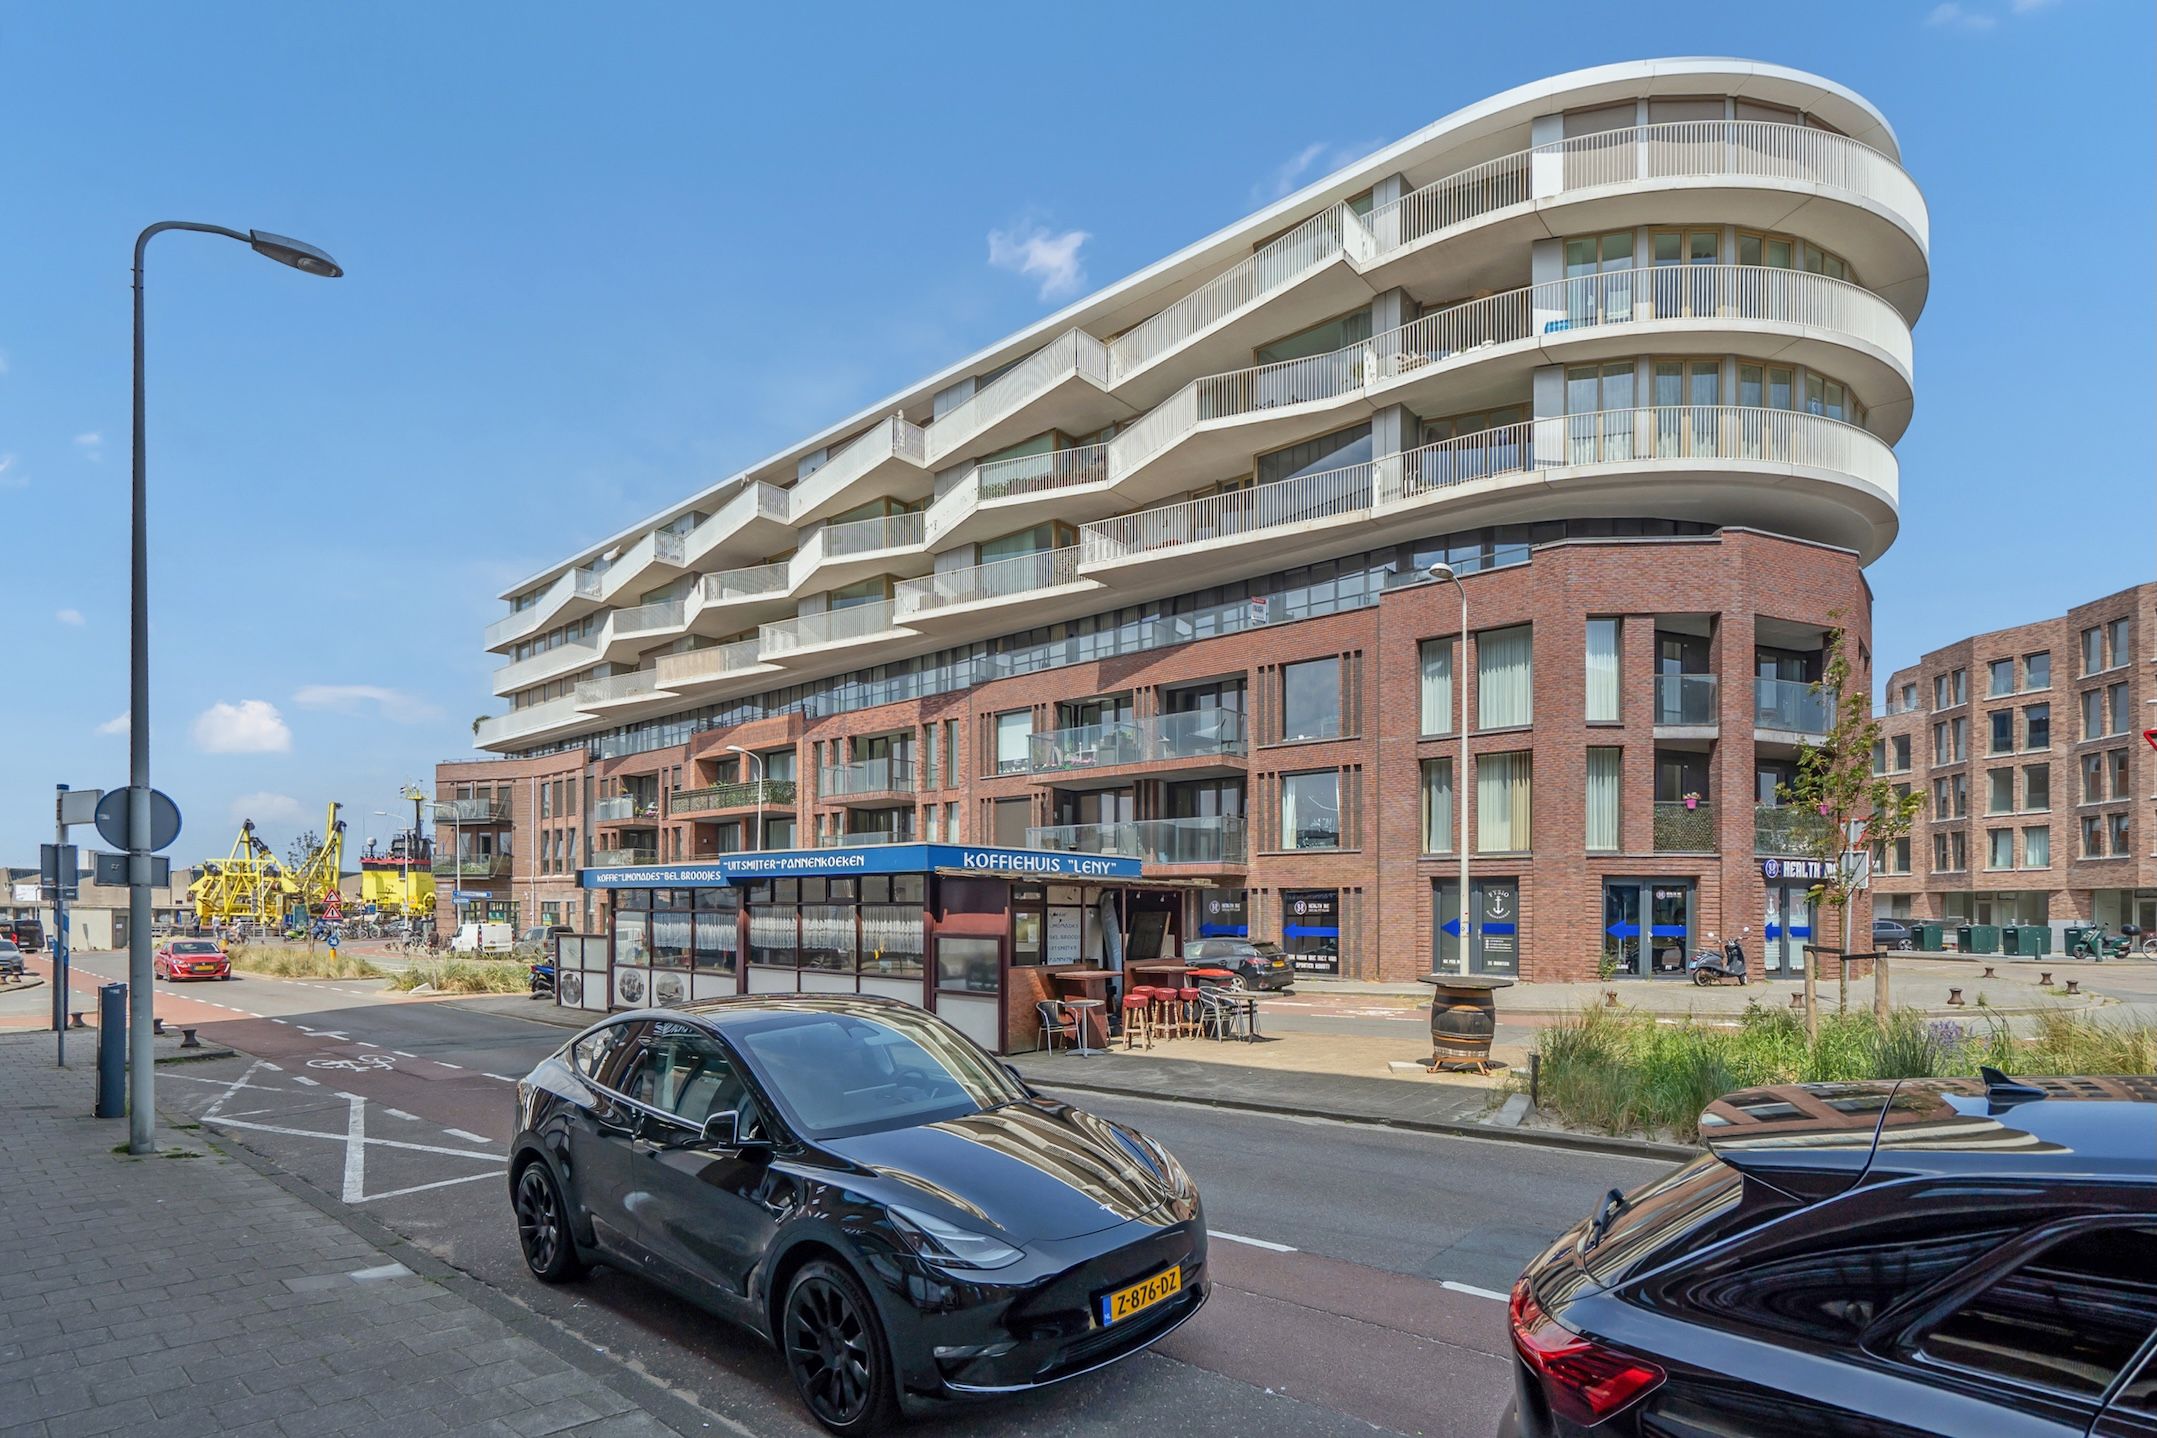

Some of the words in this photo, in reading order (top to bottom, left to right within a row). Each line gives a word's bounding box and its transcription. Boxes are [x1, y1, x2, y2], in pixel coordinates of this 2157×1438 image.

[963, 852, 1060, 872] KOFFIEHUIS
[1068, 859, 1117, 875] "LENY"
[1783, 861, 1821, 879] HEALTH
[1117, 1271, 1177, 1316] Z-876-DZ
